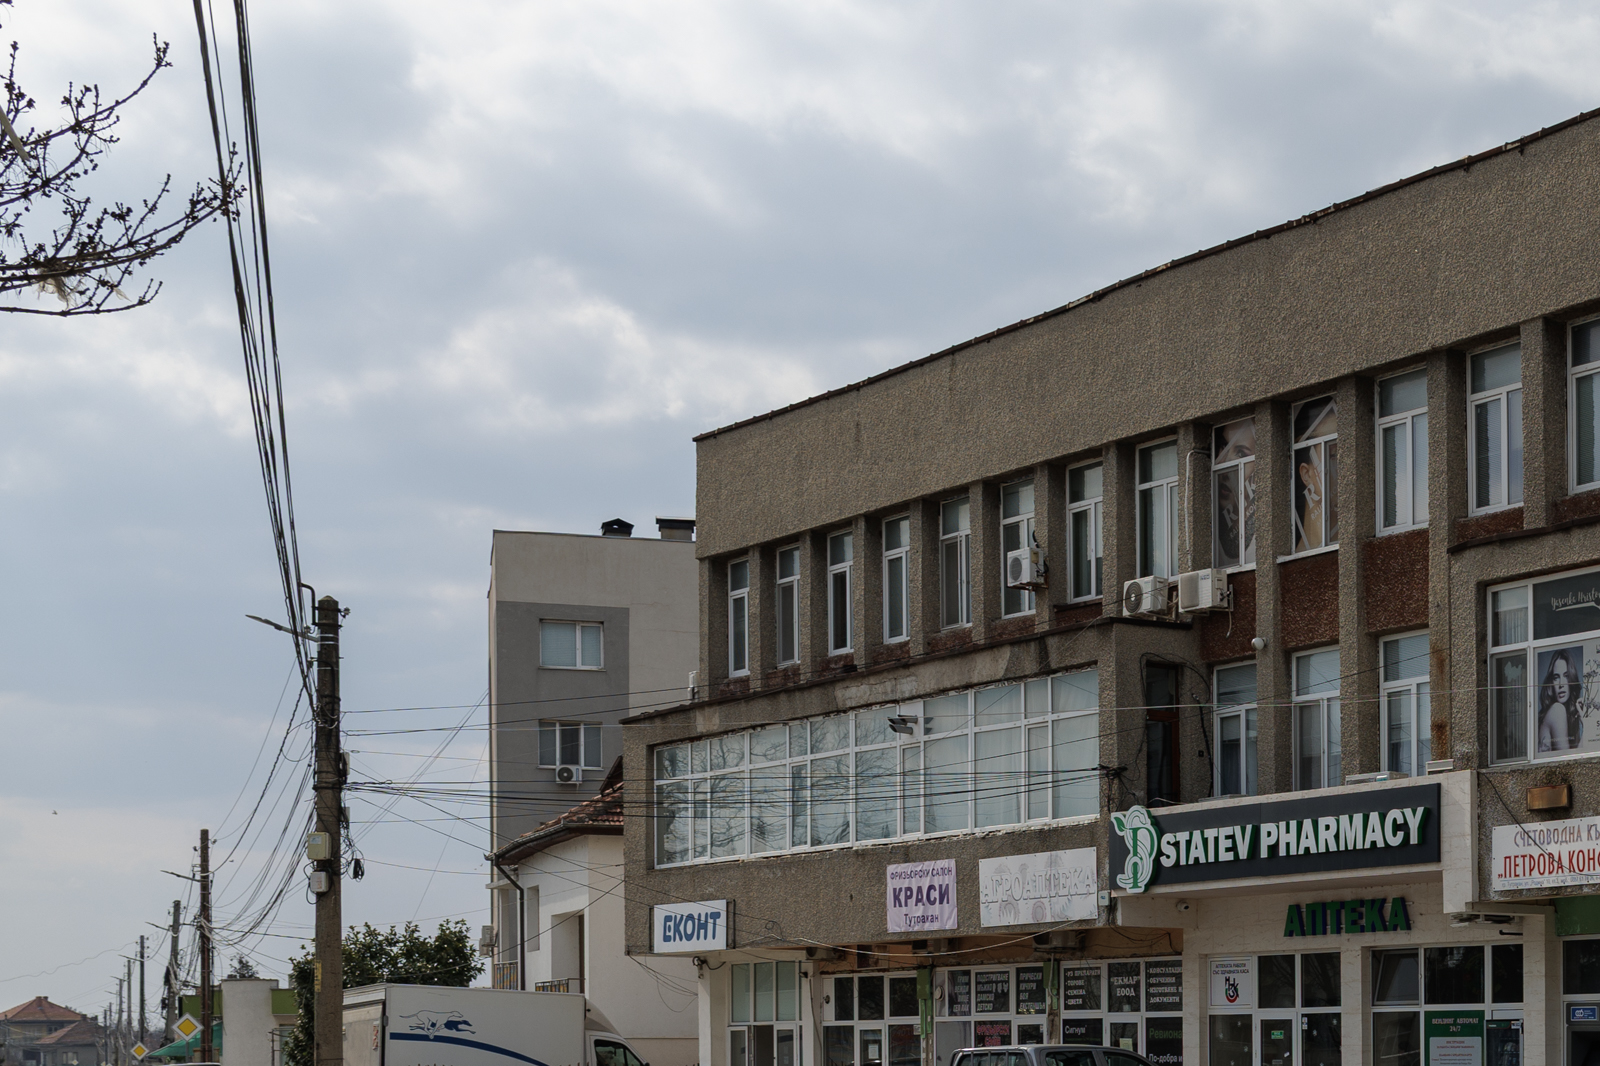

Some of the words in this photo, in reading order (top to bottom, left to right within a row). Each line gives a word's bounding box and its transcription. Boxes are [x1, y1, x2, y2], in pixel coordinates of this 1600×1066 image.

[1160, 824, 1254, 868] STATEV
[1260, 806, 1427, 858] PHARMACY
[1514, 824, 1582, 848] СЧЕТОВОДНА
[931, 866, 953, 877] САЛОН
[893, 883, 950, 908] КРАСИ
[981, 867, 1096, 905] АГРОАПТЕКА
[663, 911, 721, 942] ЕКОНТ
[904, 913, 939, 927] Тутракан
[1284, 897, 1411, 937] АПТЕКА
[1116, 988, 1136, 996] ЕООД
